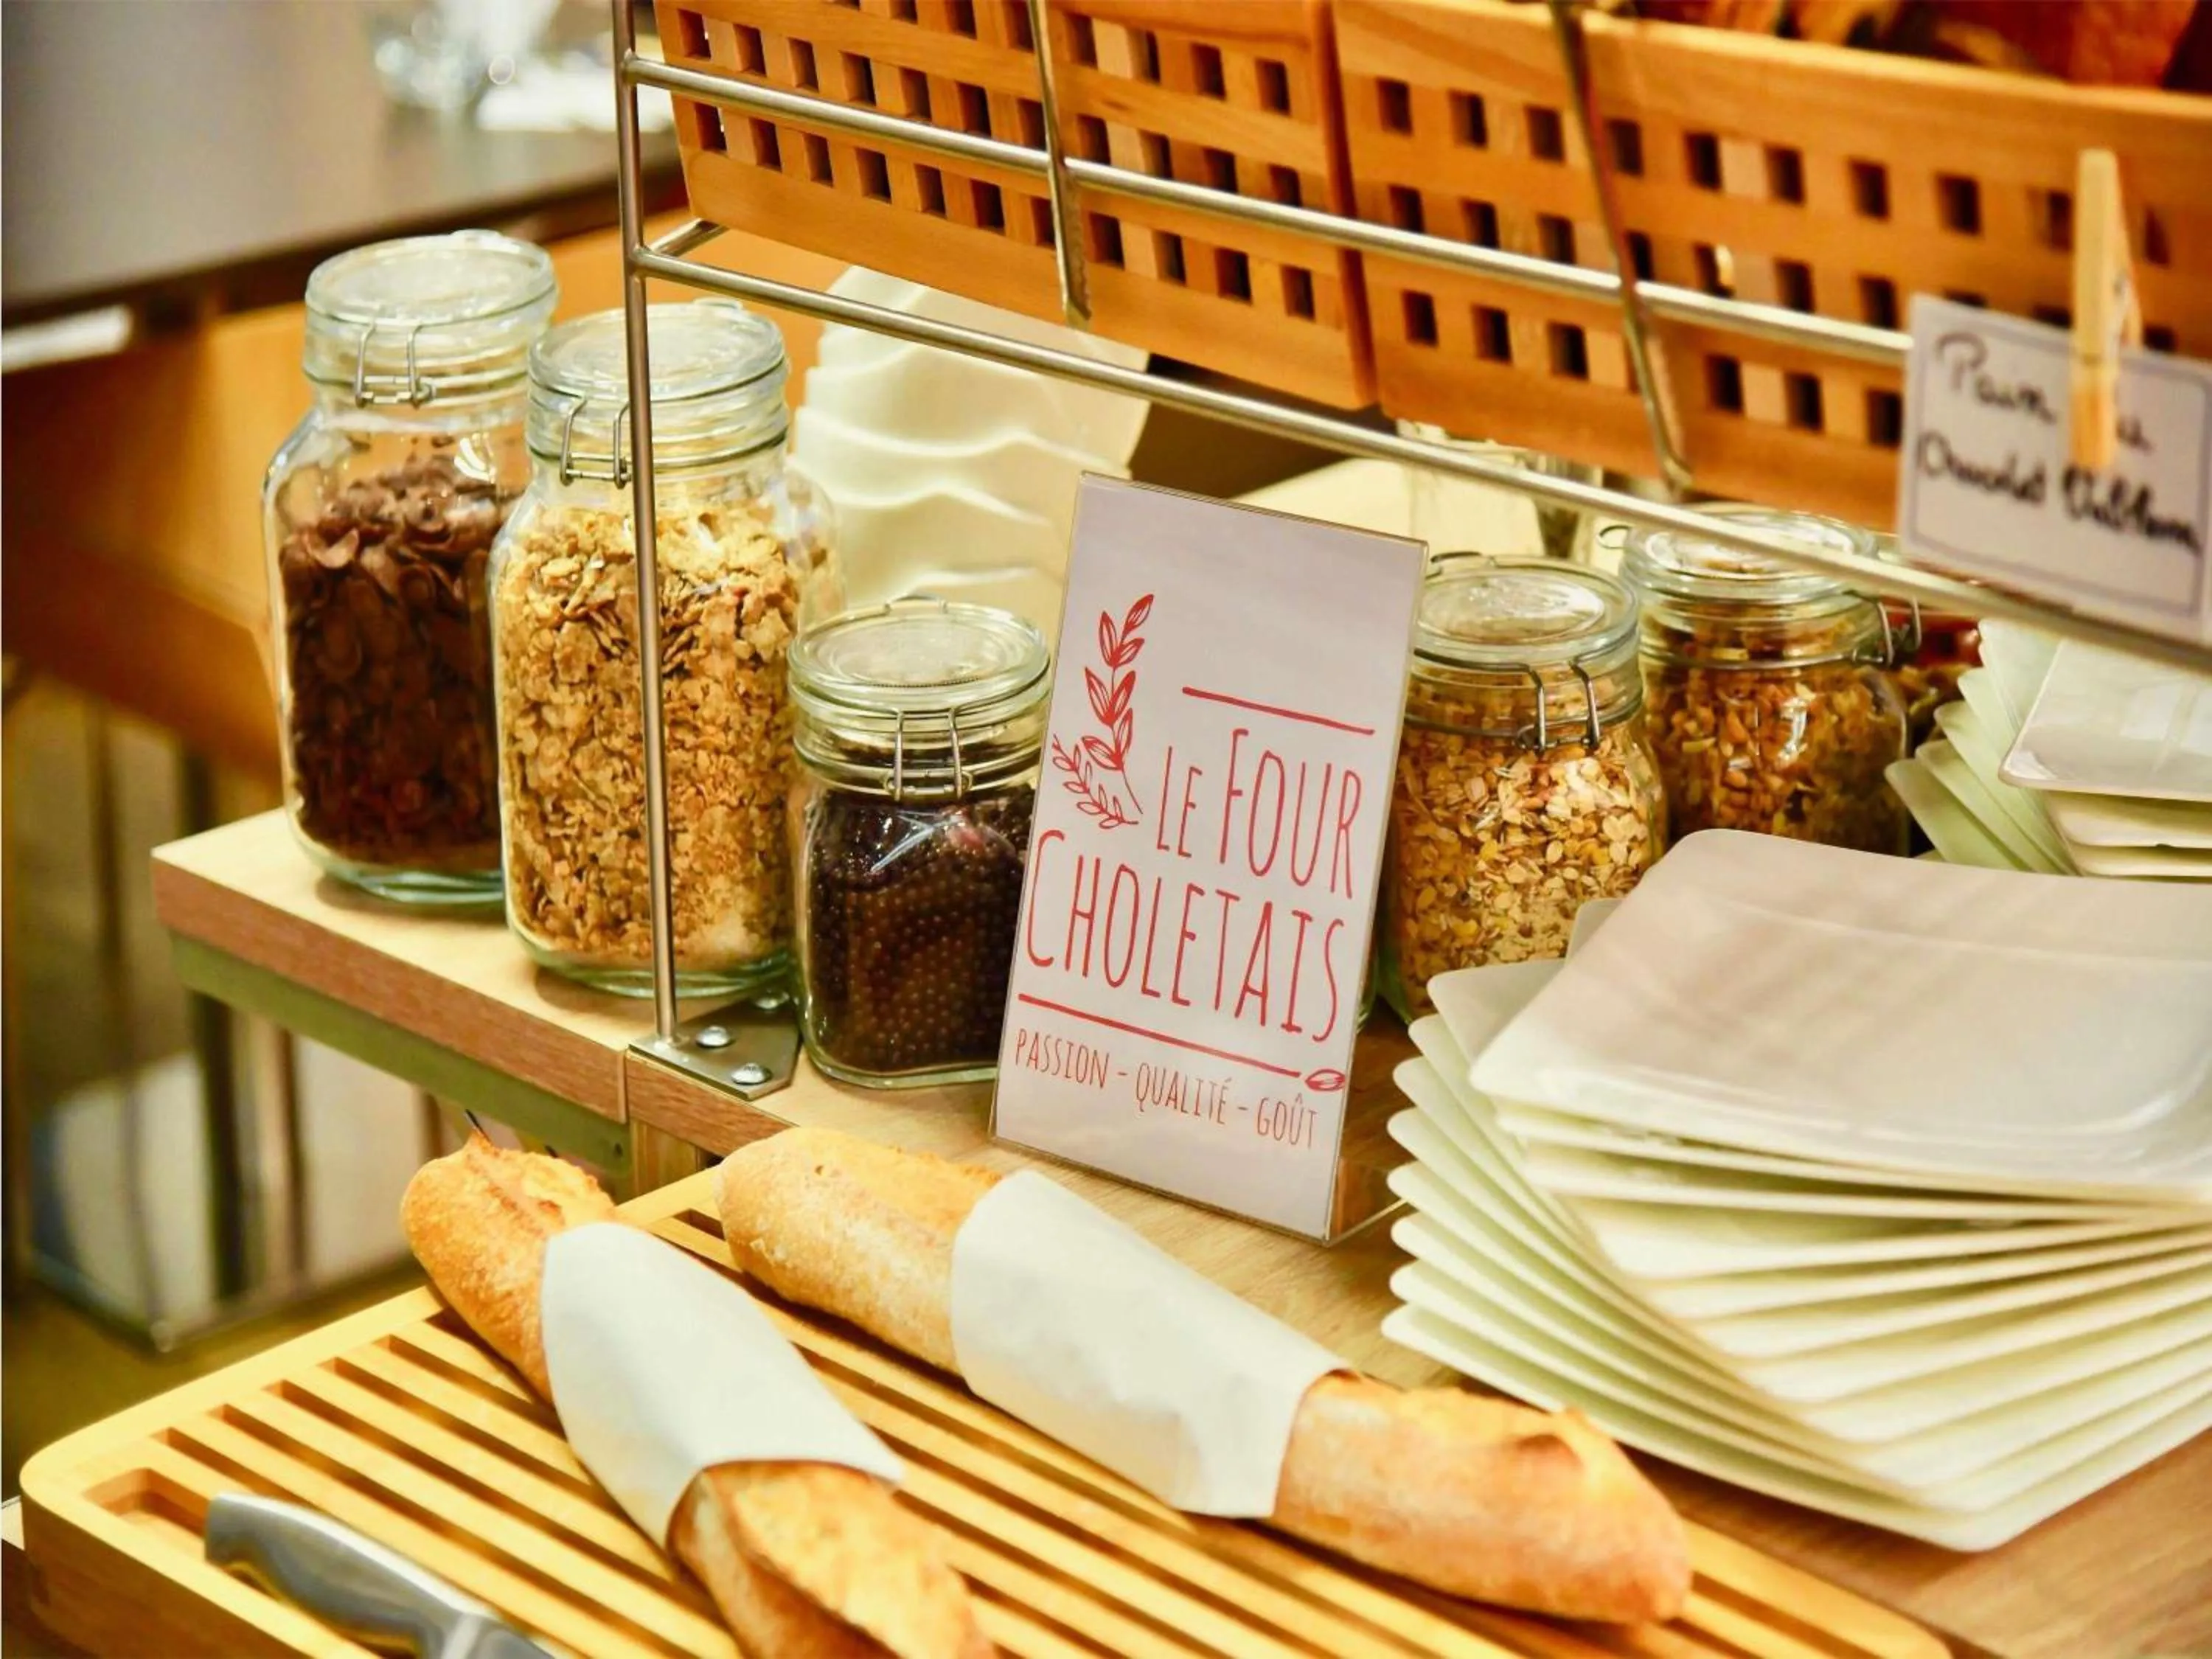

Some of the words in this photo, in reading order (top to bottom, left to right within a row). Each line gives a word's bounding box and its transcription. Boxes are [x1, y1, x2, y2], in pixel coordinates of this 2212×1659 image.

[1155, 745, 1203, 858] LE
[1218, 727, 1363, 900] FOUR
[1026, 829, 1346, 1043] CHOLETAIS
[1015, 1027, 1110, 1089] PASSION
[1135, 1062, 1234, 1125] QUALITÉ
[1256, 1093, 1319, 1150] GOÛT
